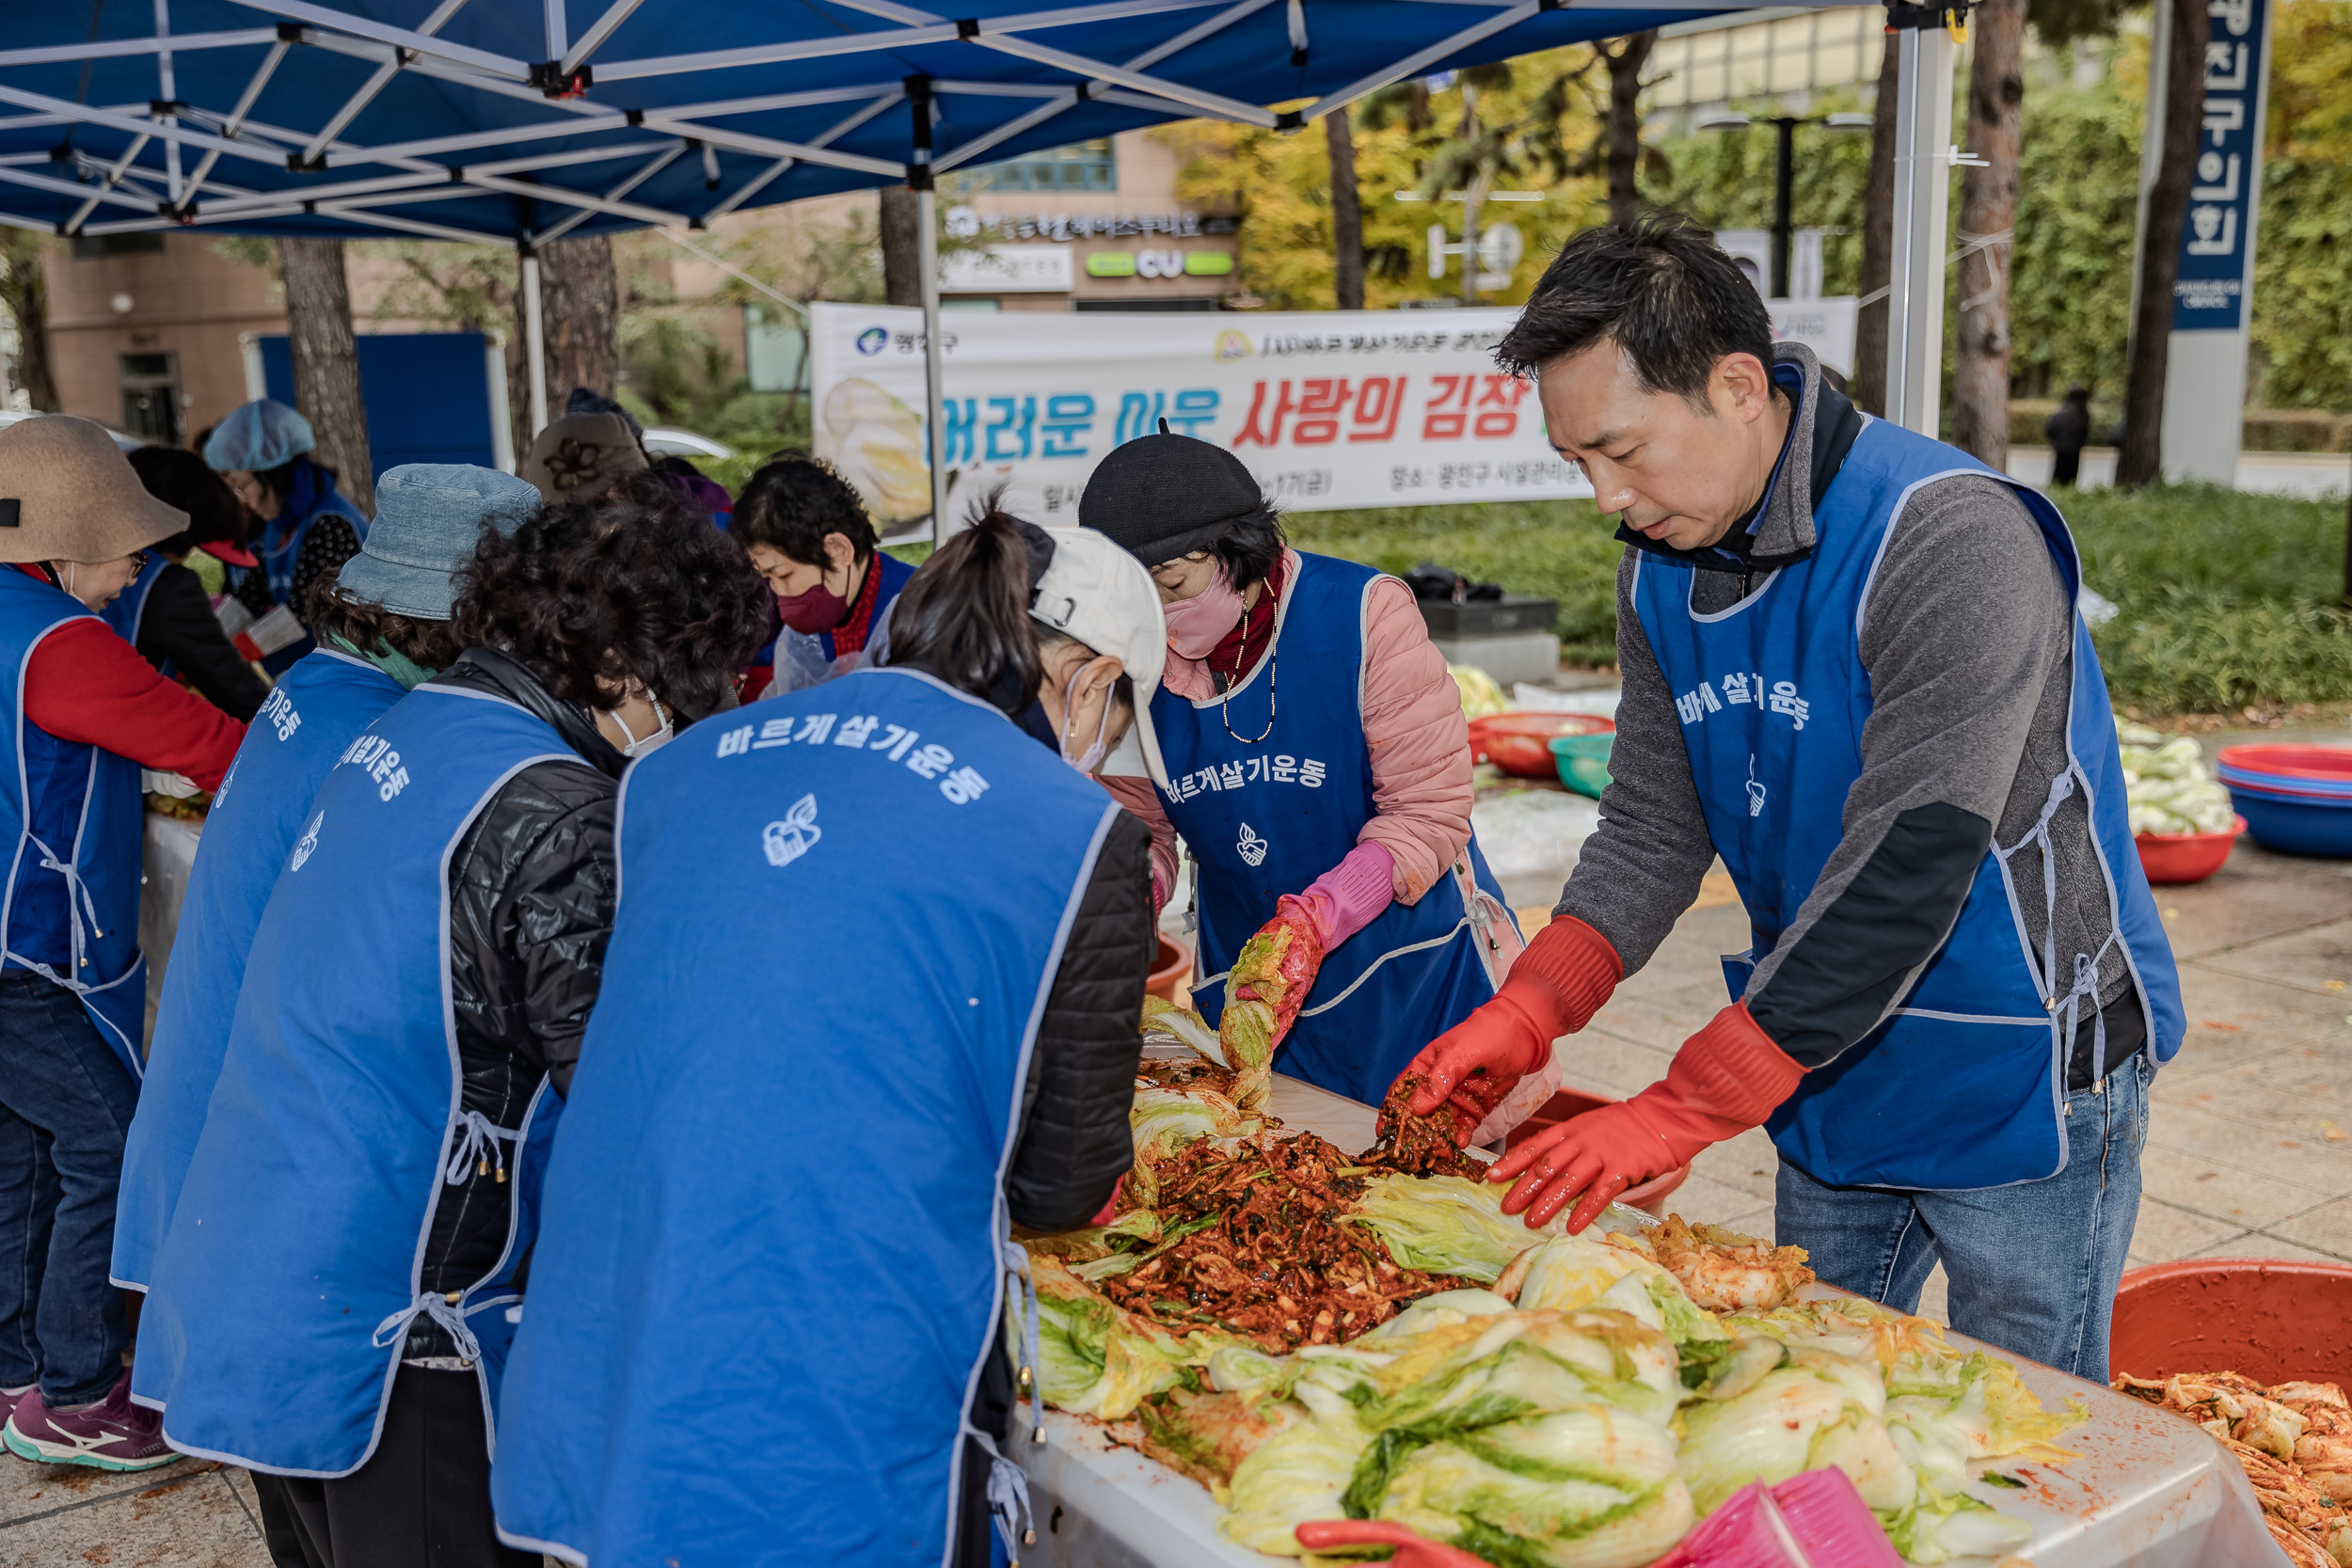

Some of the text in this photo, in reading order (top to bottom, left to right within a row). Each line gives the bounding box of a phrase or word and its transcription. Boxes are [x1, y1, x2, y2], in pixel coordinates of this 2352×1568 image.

[1136, 247, 1184, 278] CU
[1232, 375, 1408, 449] 사랑의
[1422, 372, 1531, 440] 김장
[716, 713, 991, 805] 바르게살기운동
[1166, 754, 1327, 803] 바르게살기운동
